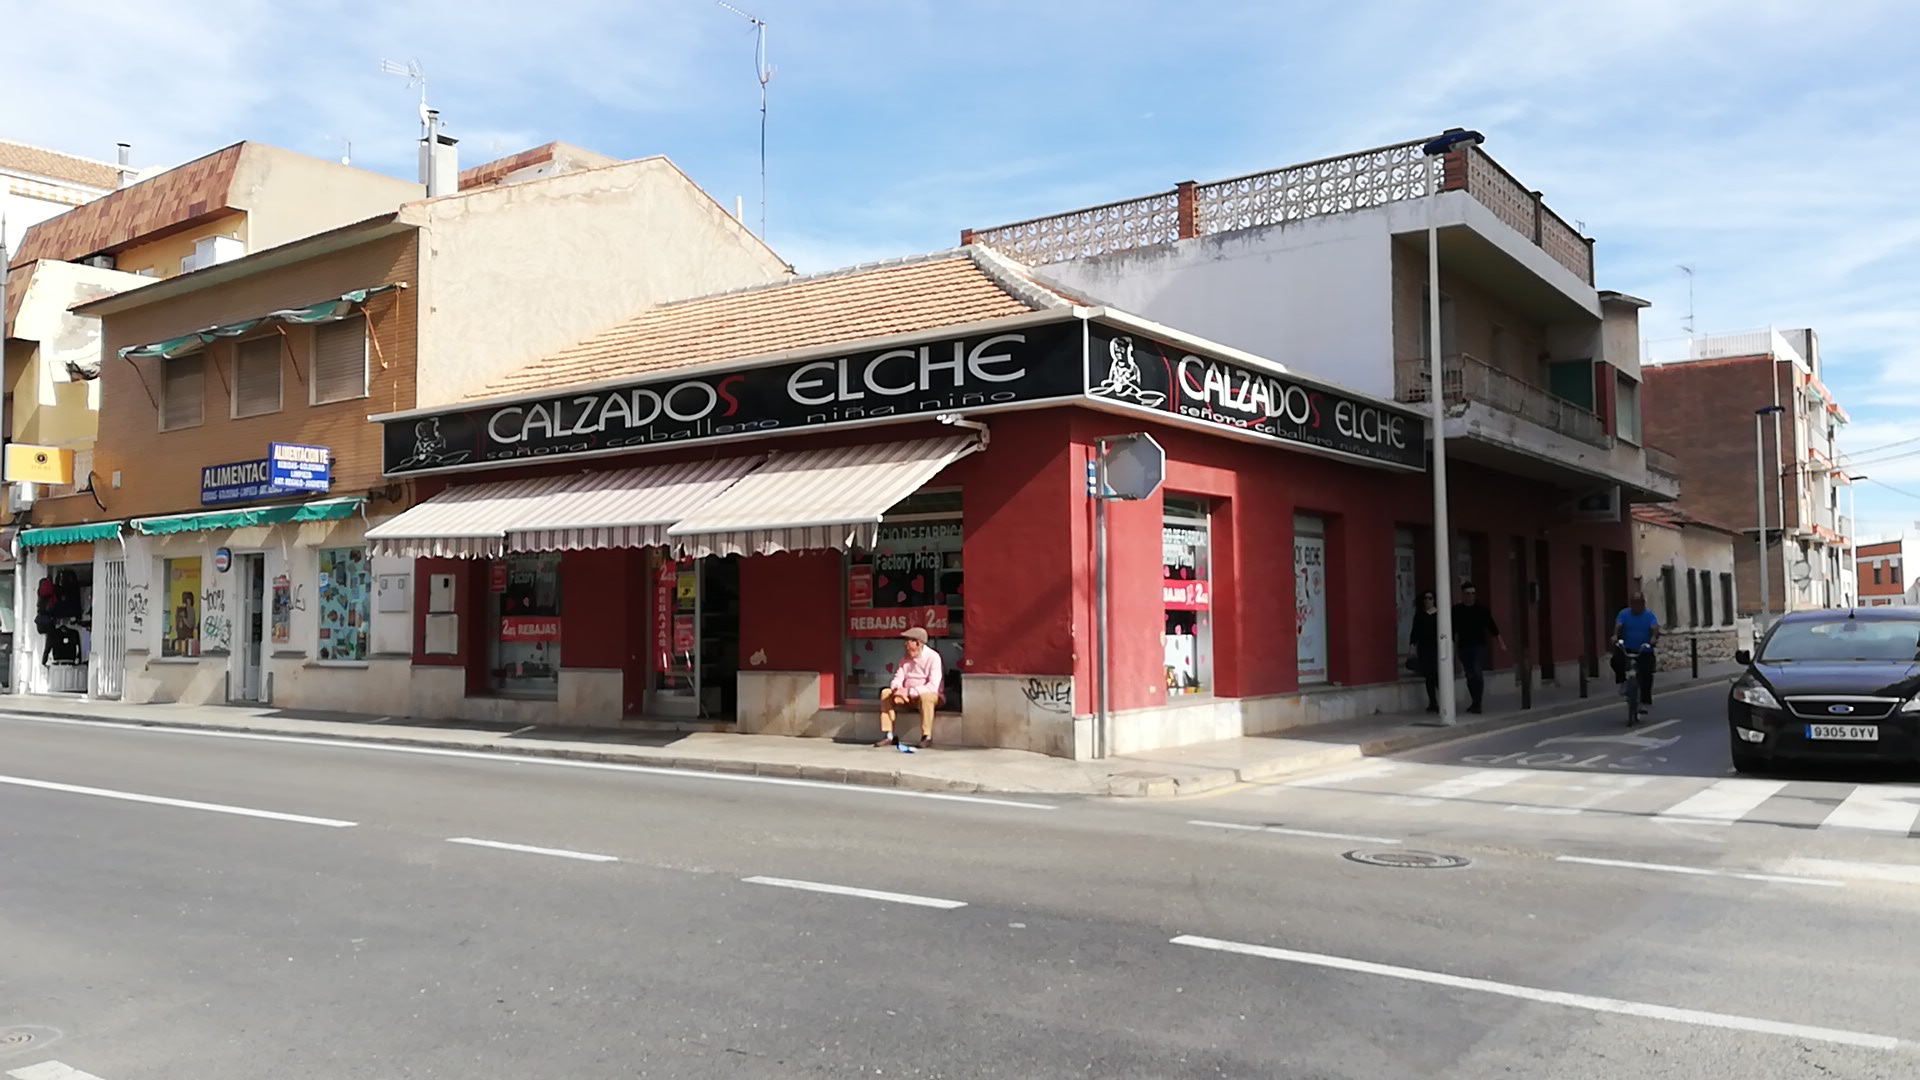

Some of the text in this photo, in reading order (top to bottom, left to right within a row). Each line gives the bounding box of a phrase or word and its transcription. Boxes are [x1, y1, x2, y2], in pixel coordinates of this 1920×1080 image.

[488, 334, 1026, 444] CALZADOS ELCHE
[1178, 355, 1405, 449] CALZADOS ELCHE
[486, 391, 1016, 459] señora caballero niña niño
[1180, 403, 1248, 428] señora
[1254, 419, 1334, 446] caballero
[517, 623, 557, 635] REBAJAS
[850, 616, 907, 631] REBAJAS
[1814, 725, 1875, 738] 9305 GYV
